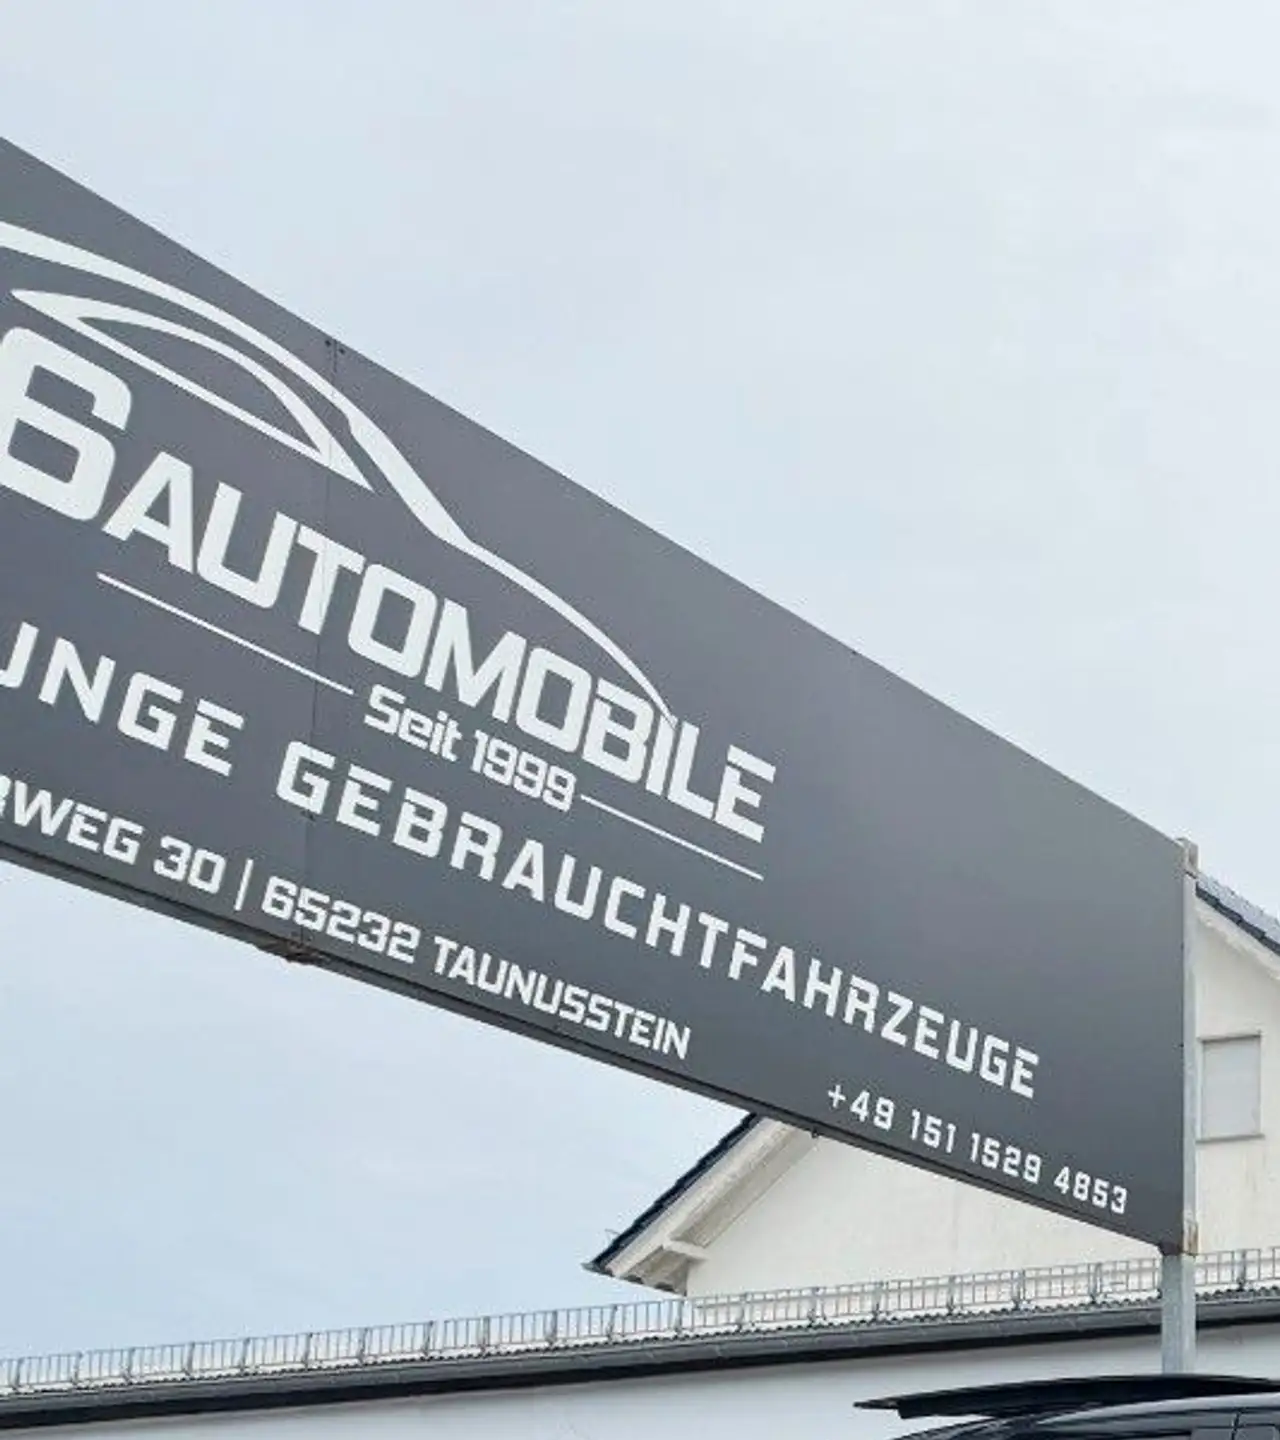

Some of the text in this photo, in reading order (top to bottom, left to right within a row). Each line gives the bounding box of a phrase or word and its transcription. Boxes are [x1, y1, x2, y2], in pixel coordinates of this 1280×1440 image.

[363, 683, 578, 813] Seit 1999
[153, 835, 226, 894] 30
[261, 875, 421, 964] 65232
[434, 935, 691, 1060] TAUNUSSTEIN
[275, 741, 1039, 1099] GEBRAUCHTFAHRZEUGE
[827, 1084, 1127, 1214] +49 151 1529 4853
